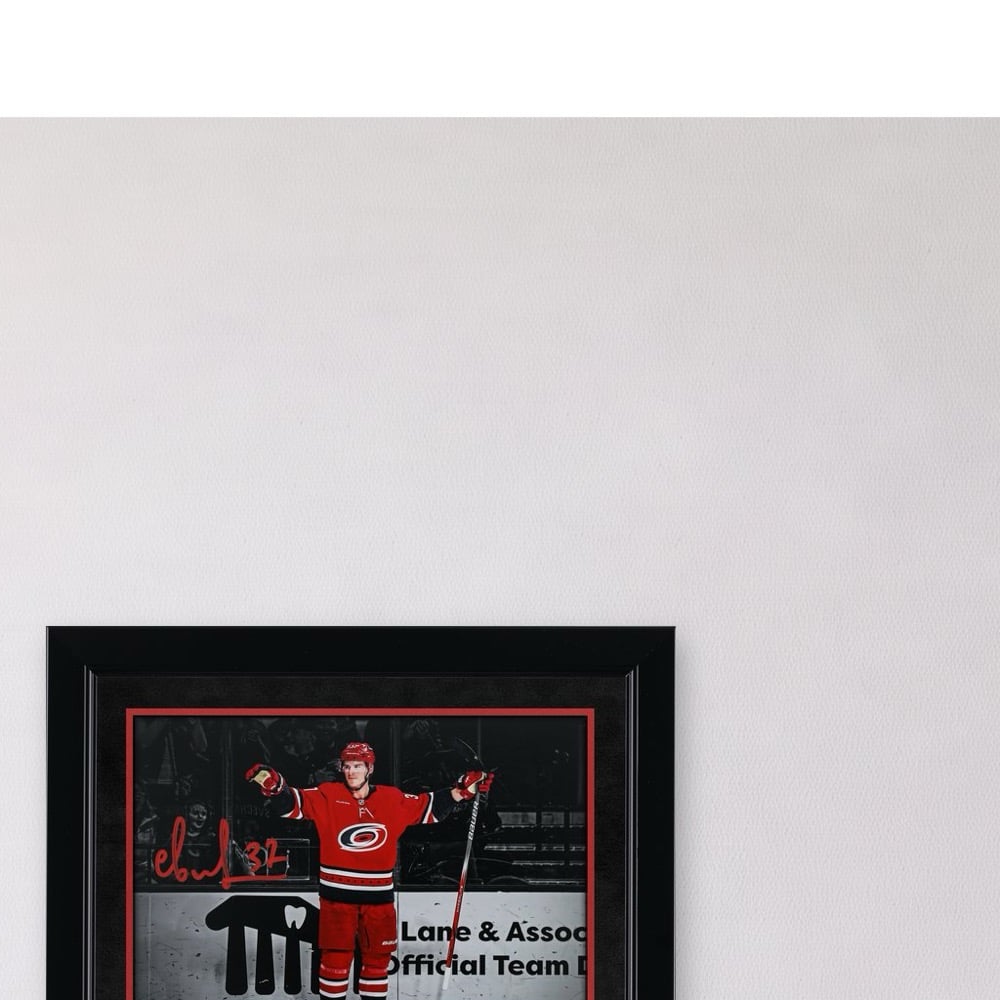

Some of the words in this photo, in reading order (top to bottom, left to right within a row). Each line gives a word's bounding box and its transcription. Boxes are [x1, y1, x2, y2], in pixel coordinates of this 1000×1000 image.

[401, 921, 471, 942] Lane
[478, 920, 500, 942] &
[493, 954, 569, 976] Team
